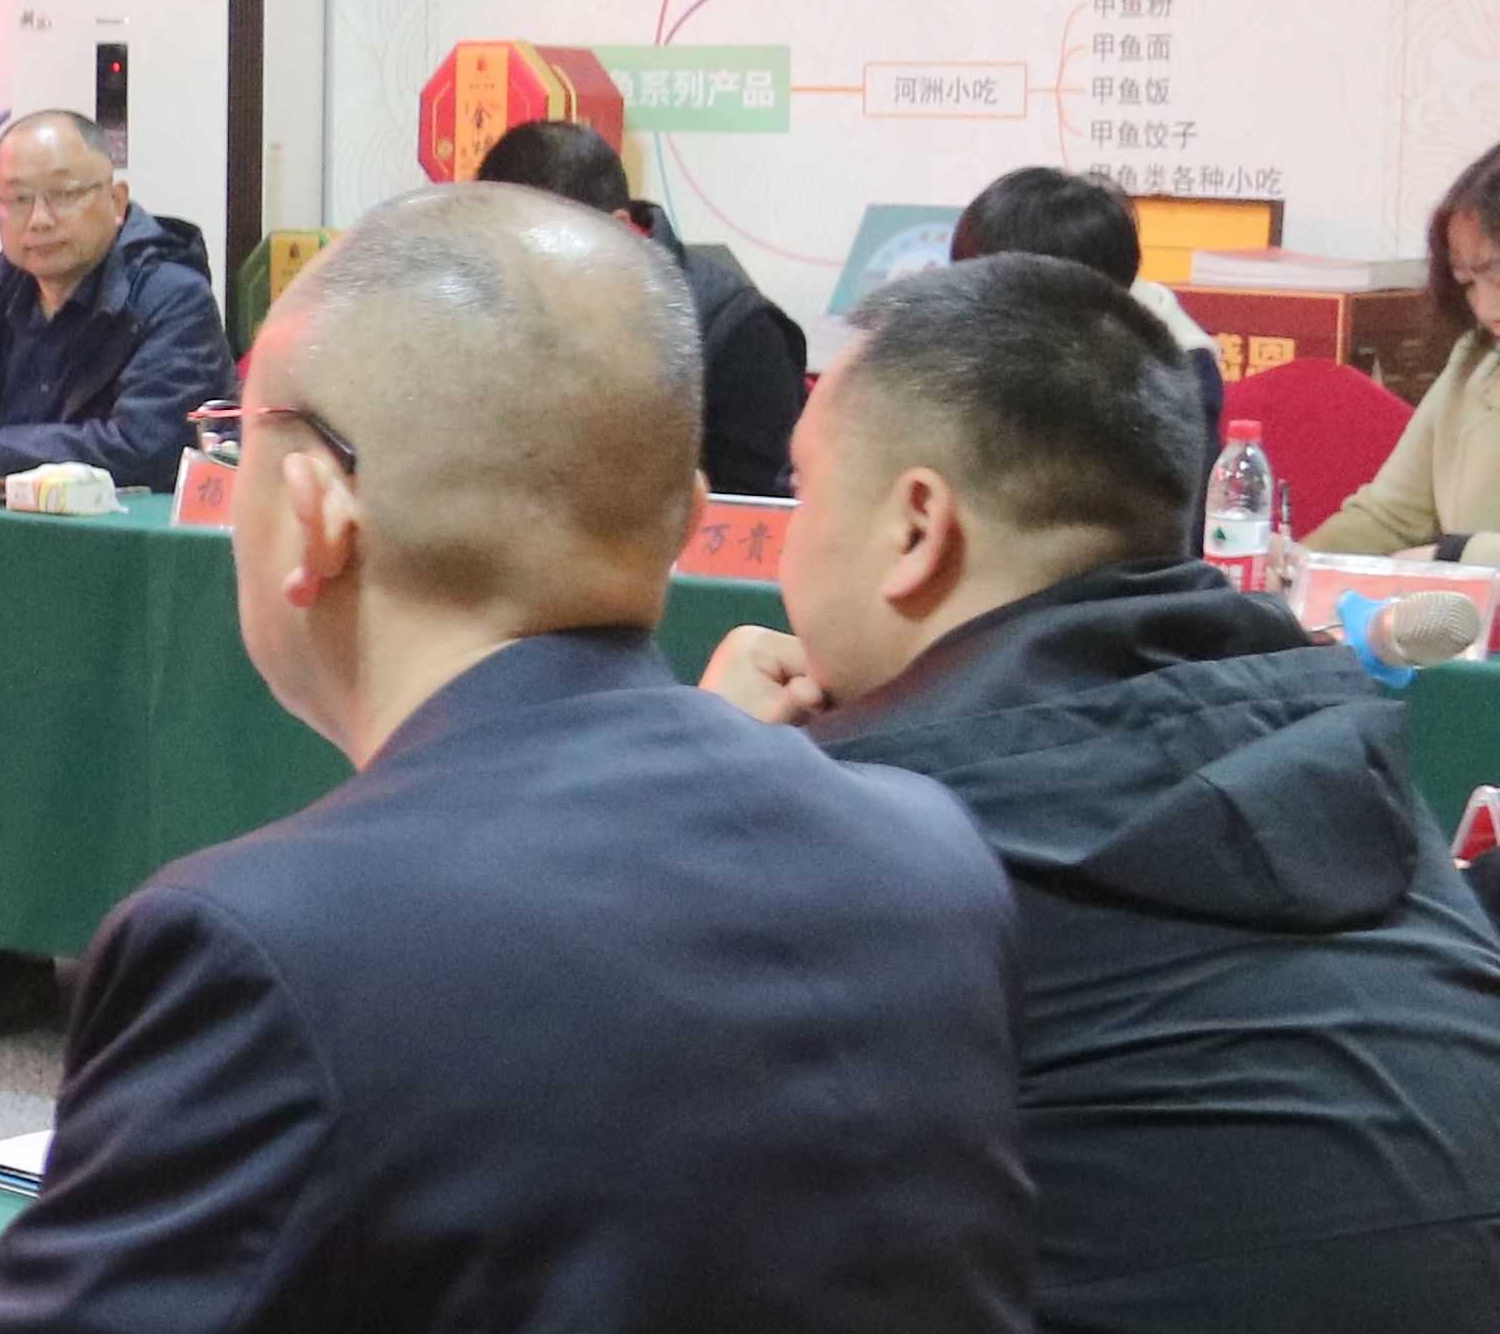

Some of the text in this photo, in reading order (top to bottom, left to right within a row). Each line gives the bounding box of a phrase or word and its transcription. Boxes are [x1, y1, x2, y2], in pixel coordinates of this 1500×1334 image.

[1092, 32, 1172, 61] 甲鱼面
[894, 77, 998, 105] 河洲小吃
[1092, 76, 1169, 105] 甲鱼饭
[1090, 119, 1198, 149] 甲鱼饺子
